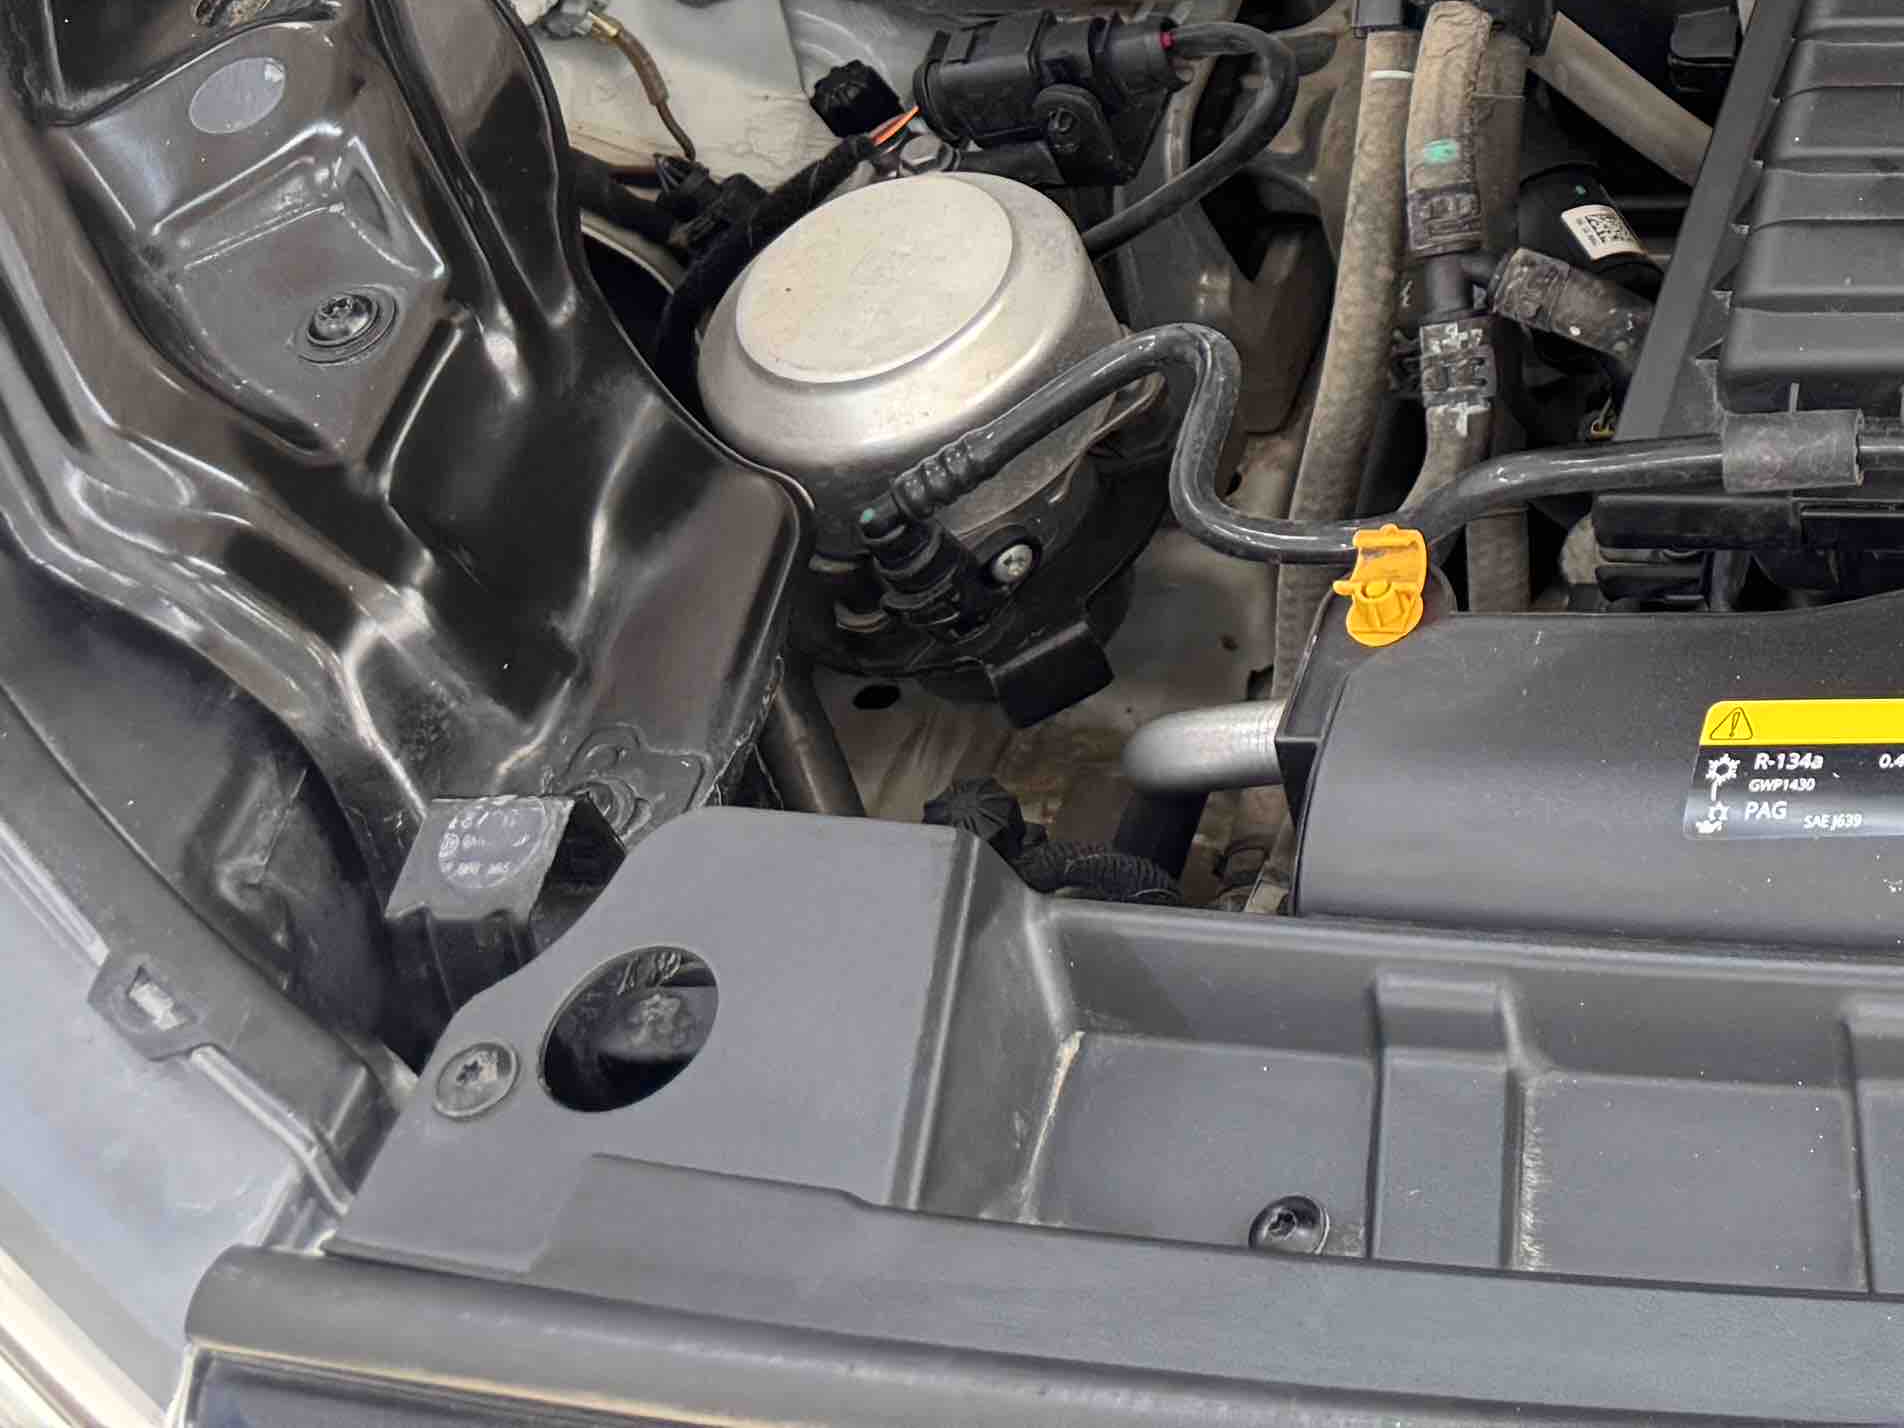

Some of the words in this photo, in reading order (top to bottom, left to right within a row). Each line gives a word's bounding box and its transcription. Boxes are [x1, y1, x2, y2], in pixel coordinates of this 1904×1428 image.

[1754, 753, 1824, 770] R-134a
[1749, 778, 1816, 792] GWP1430
[1744, 801, 1788, 820] PAG
[1804, 816, 1829, 830] SAE
[1830, 813, 1863, 832] J639
